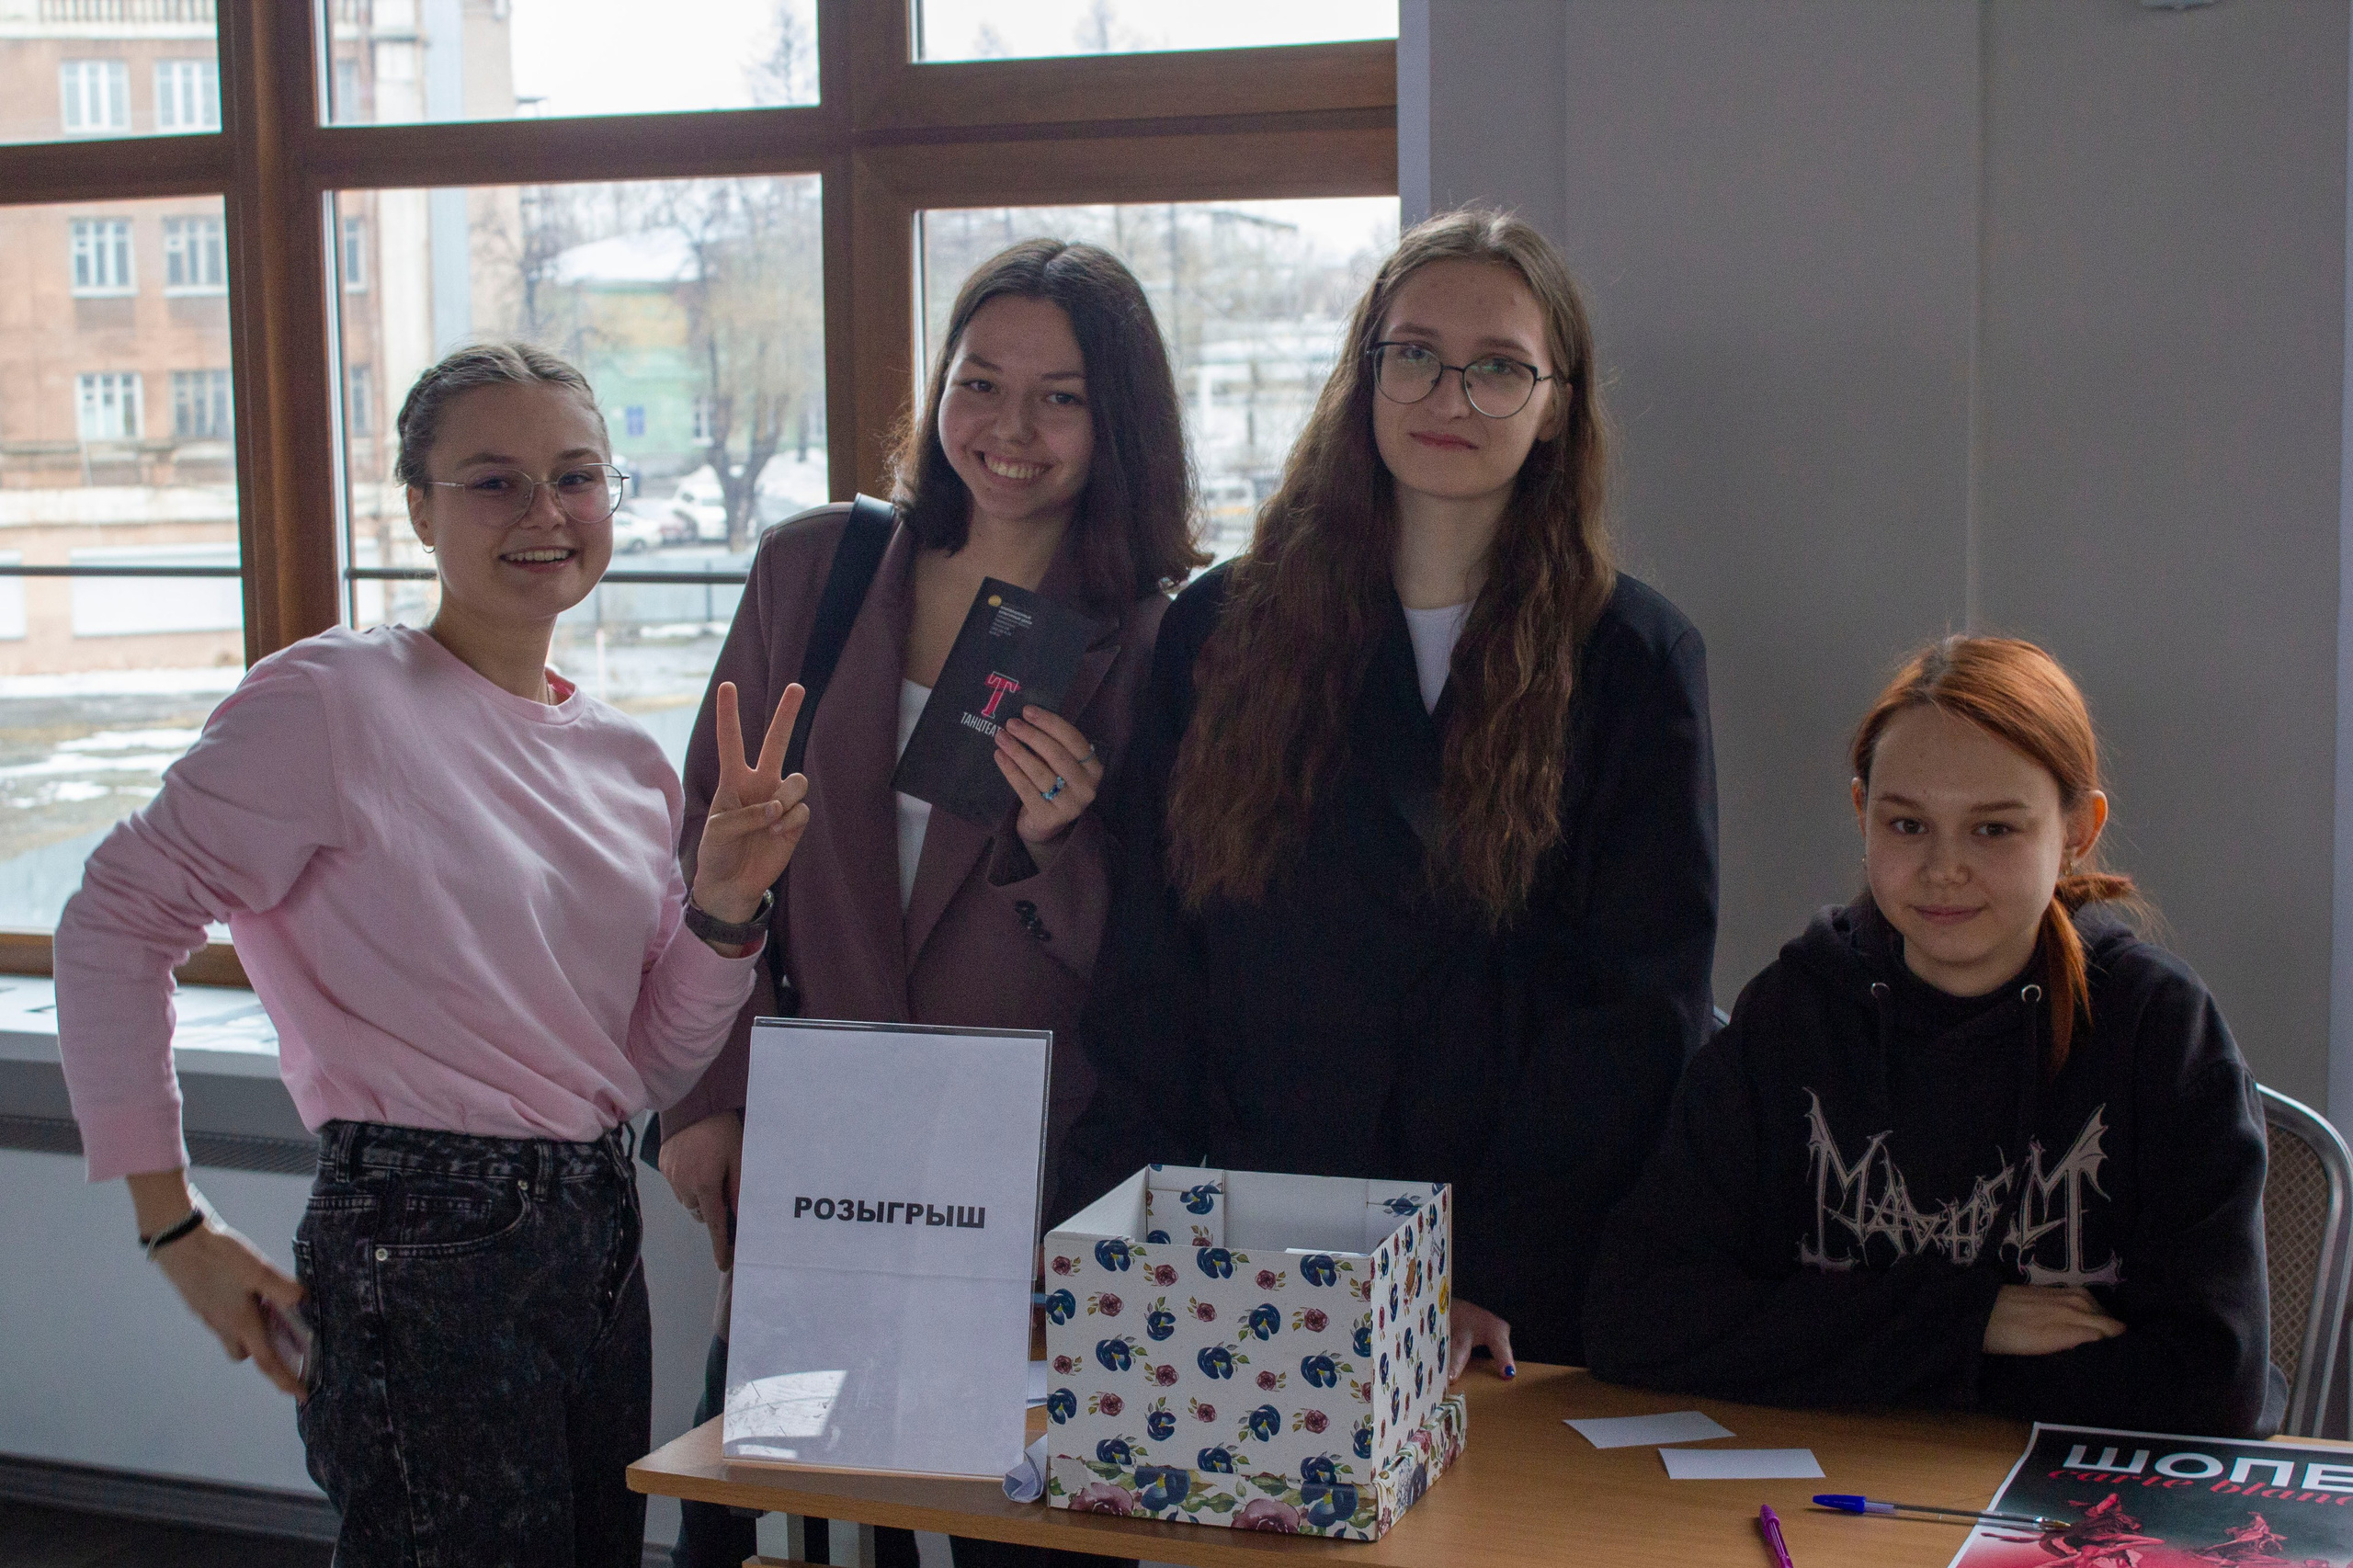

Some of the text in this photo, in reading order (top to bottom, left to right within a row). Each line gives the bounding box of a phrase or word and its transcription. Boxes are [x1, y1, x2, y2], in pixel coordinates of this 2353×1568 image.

[960, 711, 1004, 737] ТАНЦТЕАТ
[793, 1196, 986, 1229] РОЗЫГРЫШ
[2048, 1470, 2194, 1488] carte
[2063, 1444, 2353, 1493] ШОПЕ
